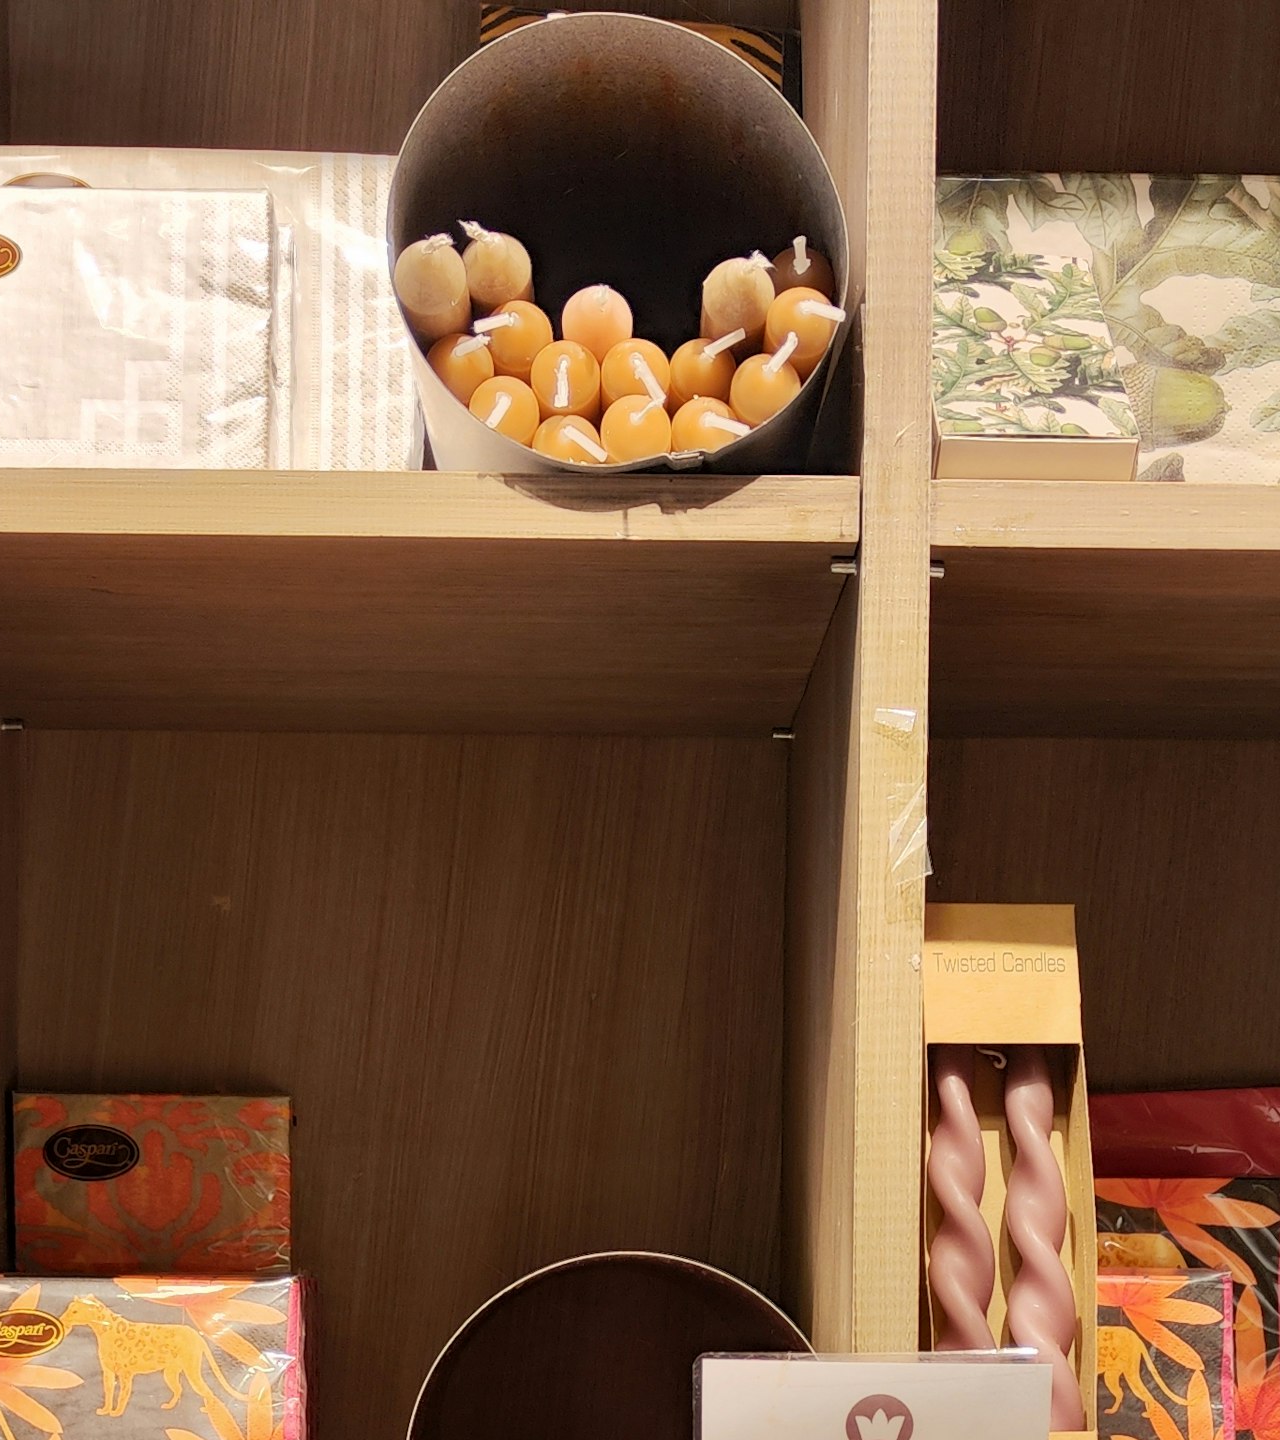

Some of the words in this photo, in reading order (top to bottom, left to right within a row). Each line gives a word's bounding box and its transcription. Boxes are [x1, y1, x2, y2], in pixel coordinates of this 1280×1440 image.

[932, 952, 995, 973] Twisted
[1002, 952, 1066, 973] Candles
[53, 1136, 130, 1169] Caspari
